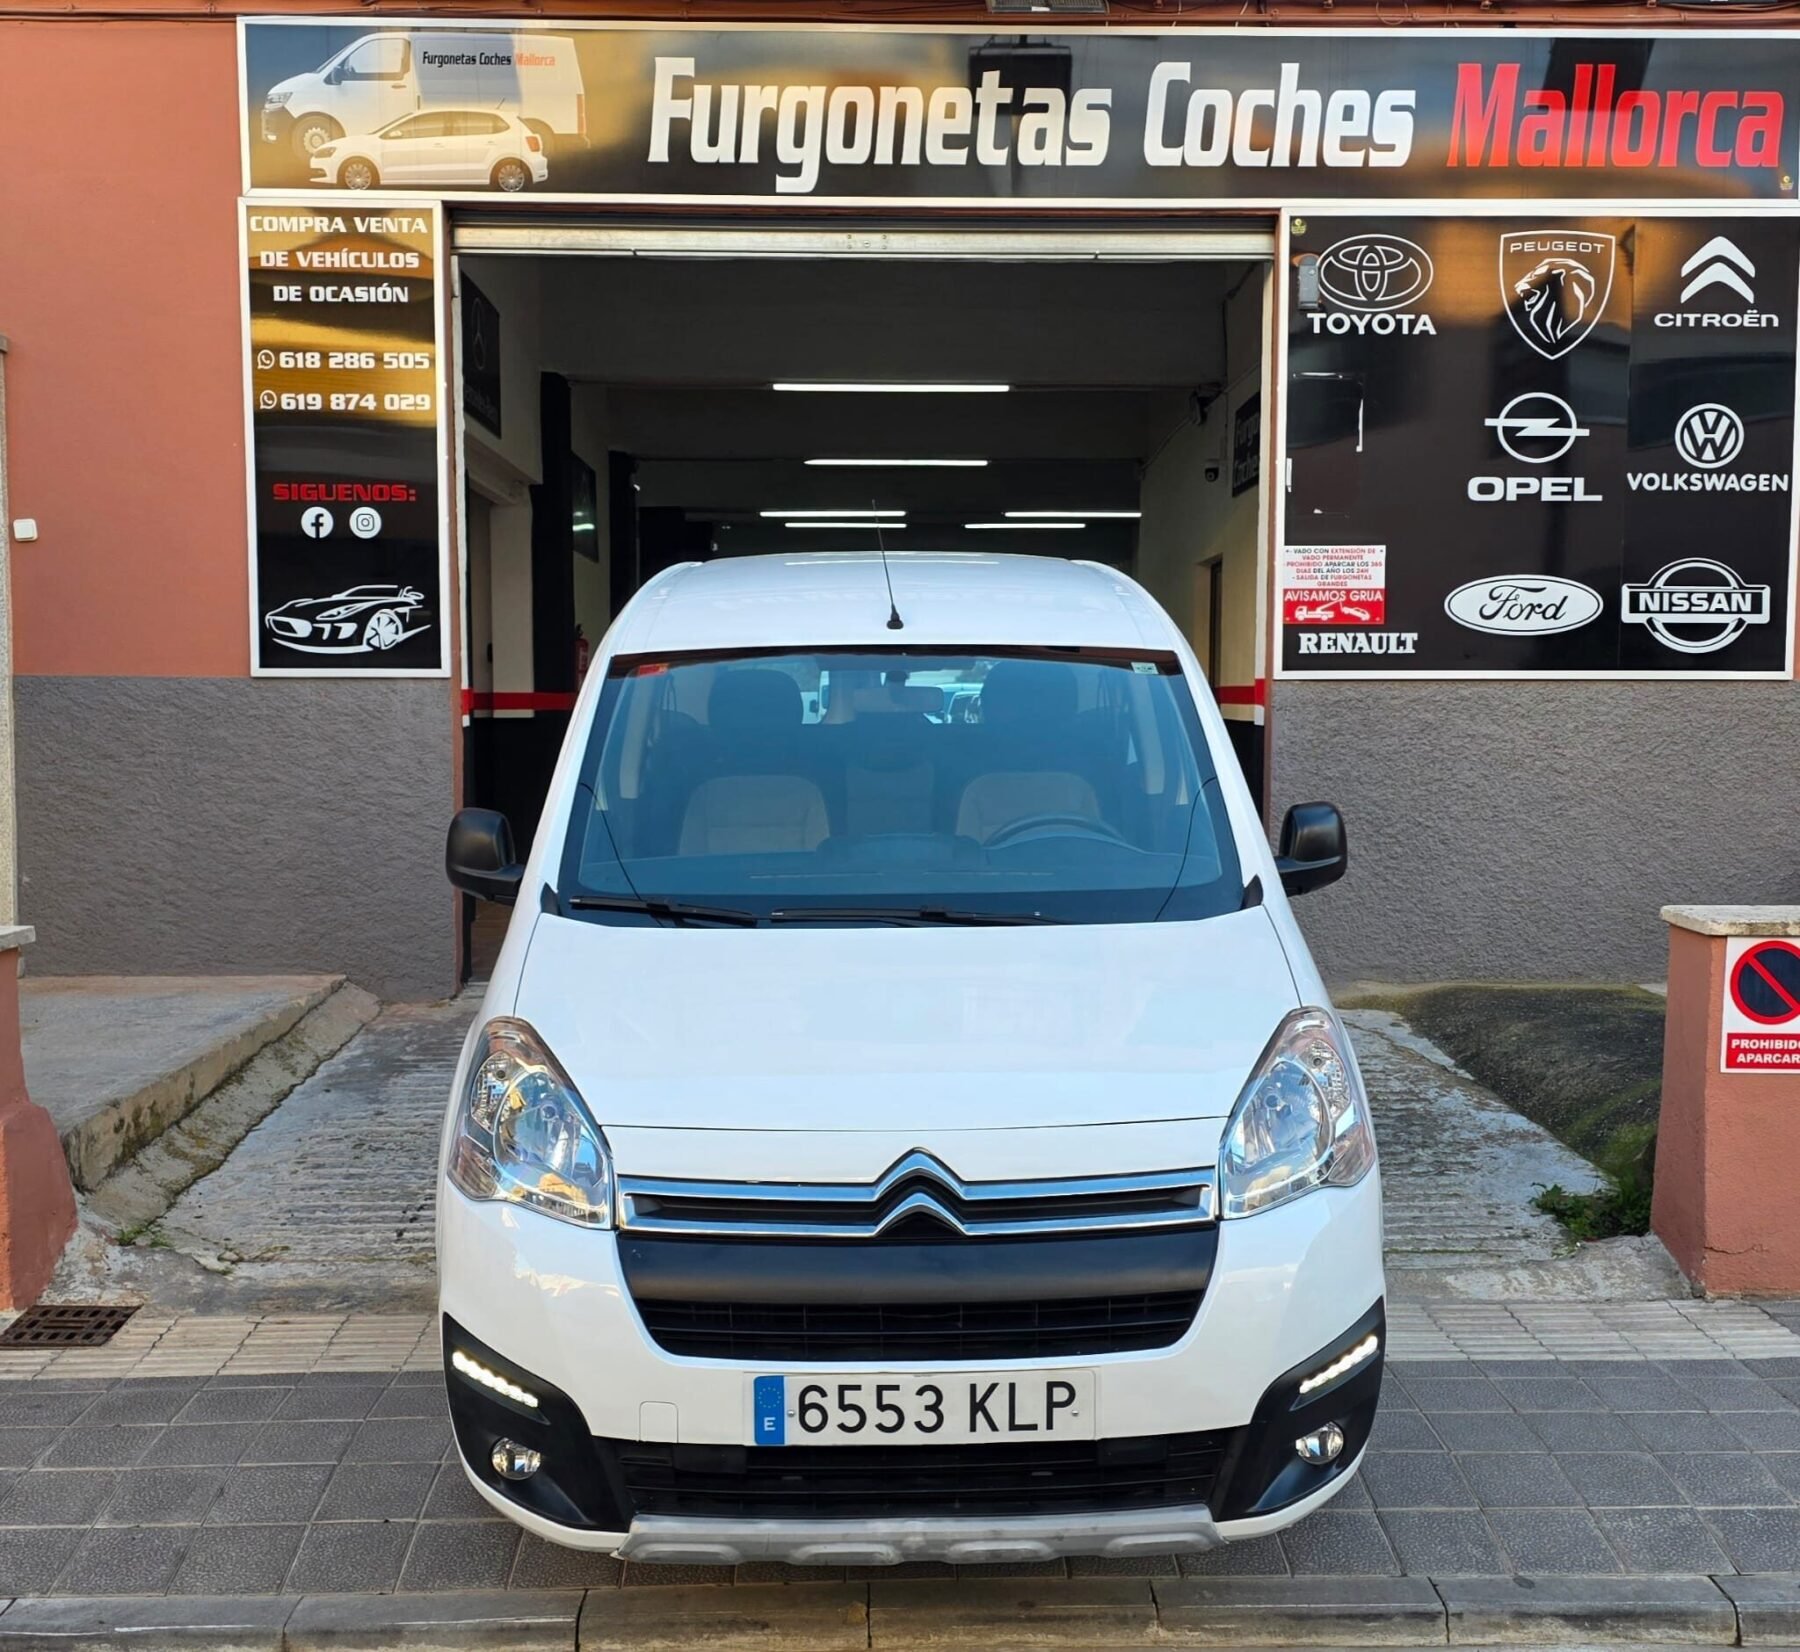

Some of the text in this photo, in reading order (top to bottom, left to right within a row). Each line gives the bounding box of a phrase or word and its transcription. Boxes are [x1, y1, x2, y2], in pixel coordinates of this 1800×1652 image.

[423, 51, 556, 68] Furgonetas Coches Mallorca
[647, 56, 1786, 194] Furgonetas Coches Mallorca
[250, 216, 428, 233] COMPRA VENTA
[1510, 241, 1605, 254] PEUGEOT
[260, 248, 420, 269] DE VEHÍCULOS
[272, 283, 409, 303] DE OCASIÓN
[1306, 312, 1437, 335] TOYOTA
[279, 352, 430, 369] 618 286 505
[280, 393, 431, 410] 619 874 029
[1467, 476, 1603, 501] OPEL
[1627, 472, 1789, 492] VOLKSWAGEN
[272, 483, 417, 502] SIGUENOS:
[1284, 590, 1384, 602] AVISAMOS GRUA
[1479, 584, 1569, 621] Ford
[1639, 592, 1752, 613] NISSAN
[1298, 632, 1419, 654] RENAULT
[1731, 1039, 1800, 1050] PROHIBID
[1736, 1053, 1800, 1064] APARCAR
[798, 1380, 1077, 1434] 6553 KLP
[764, 1417, 776, 1431] E
